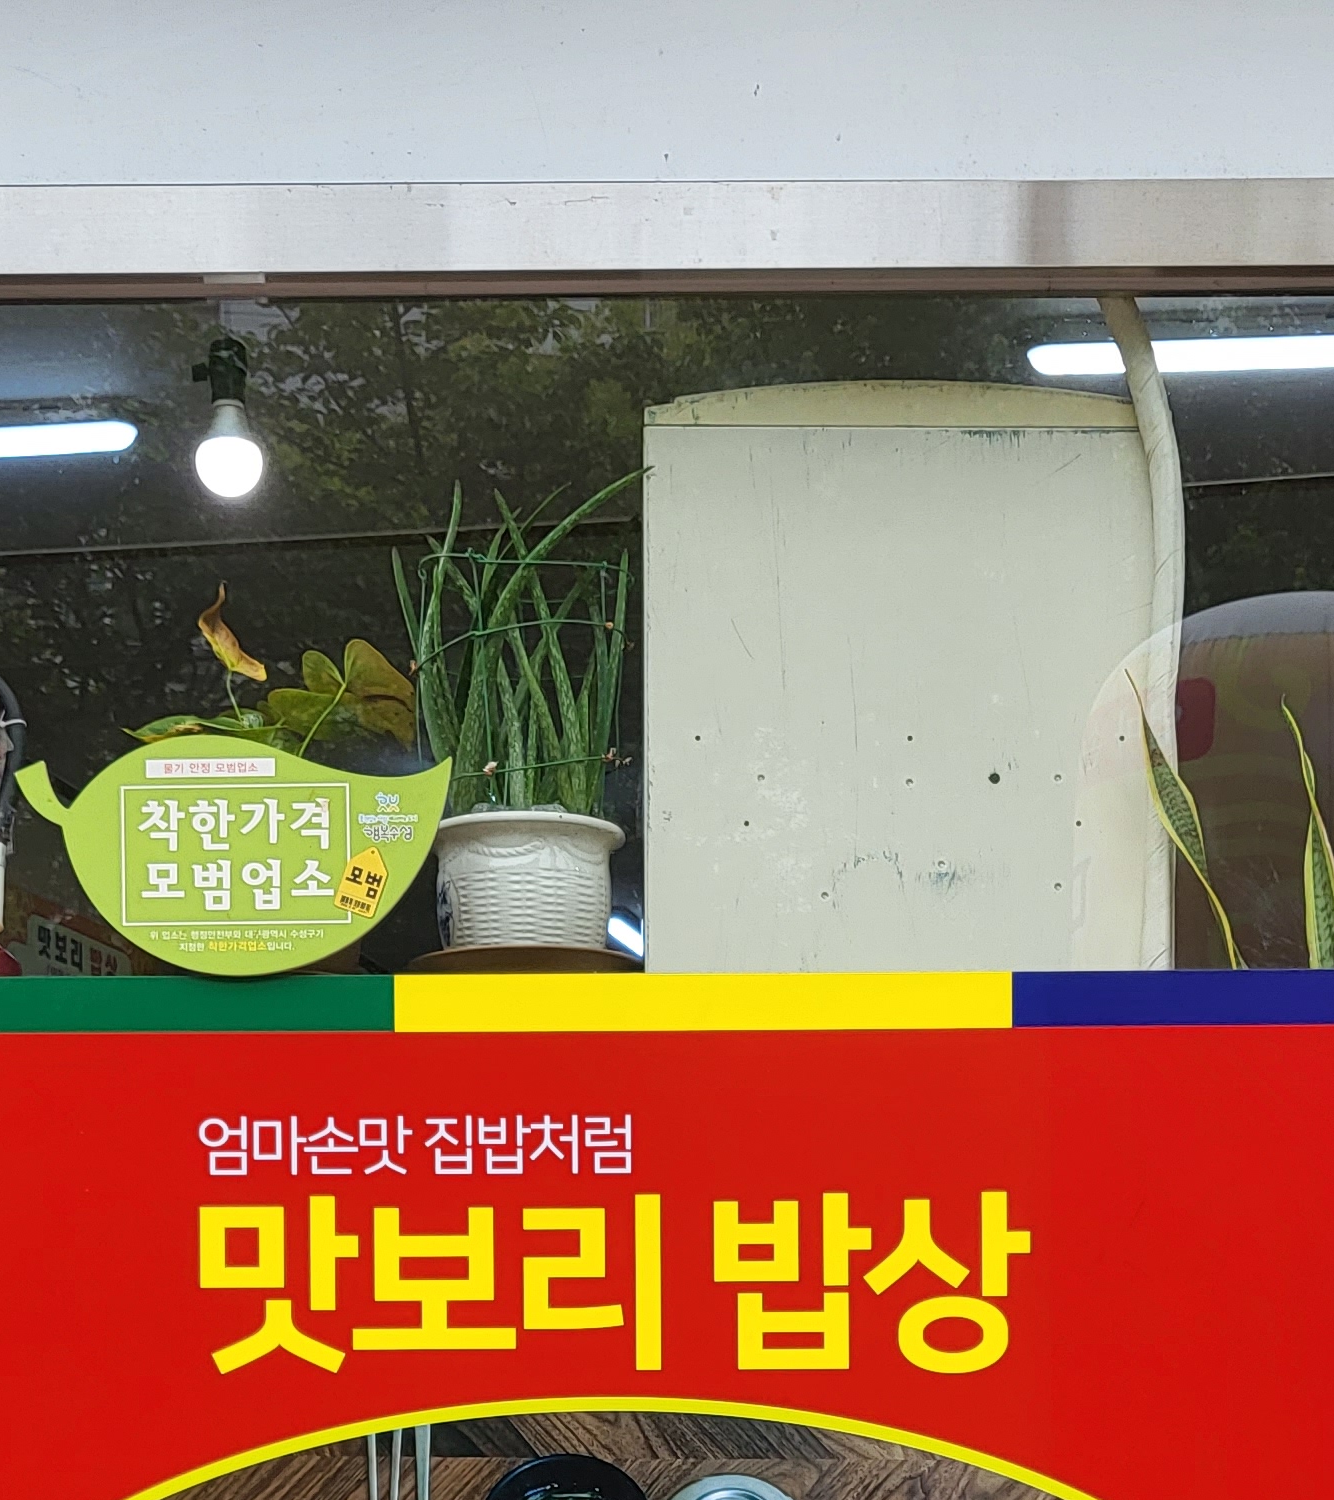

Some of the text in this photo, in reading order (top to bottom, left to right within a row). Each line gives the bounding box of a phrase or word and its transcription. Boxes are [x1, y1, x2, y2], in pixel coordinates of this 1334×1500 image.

[215, 761, 258, 773] 모범업소
[138, 799, 331, 852] 착한가격
[140, 859, 335, 911] 모범업소
[345, 866, 383, 899] 모범
[198, 1114, 632, 1176] 엄마손맛 집밥처럼
[198, 1190, 1032, 1375] 맛보리 밥상
